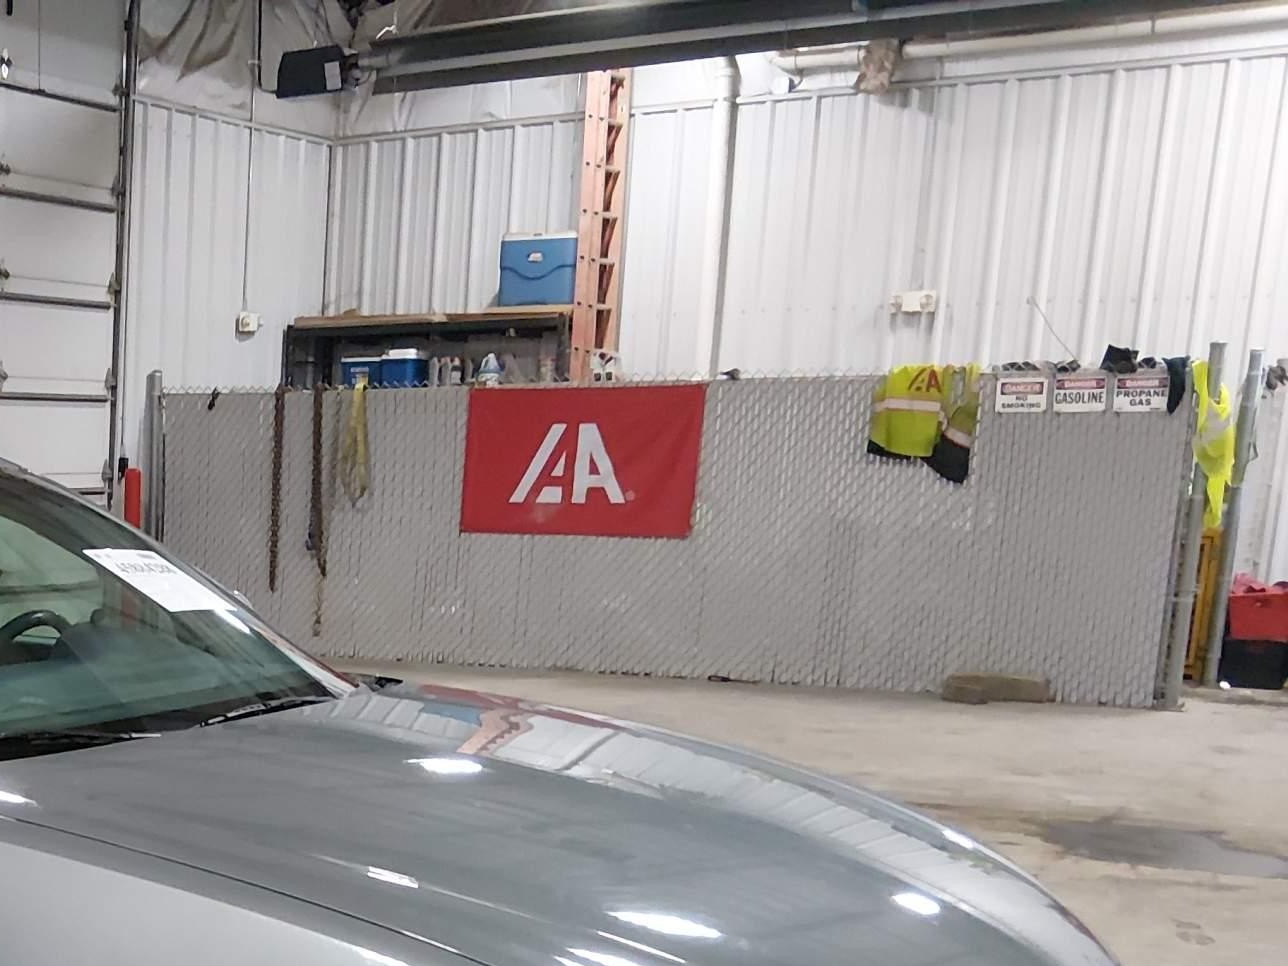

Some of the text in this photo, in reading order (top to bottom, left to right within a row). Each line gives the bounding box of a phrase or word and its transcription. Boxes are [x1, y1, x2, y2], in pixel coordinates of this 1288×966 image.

[1055, 391, 1105, 405] GASOLINE
[1116, 389, 1168, 398] PROPANE
[1129, 398, 1152, 407] GAS
